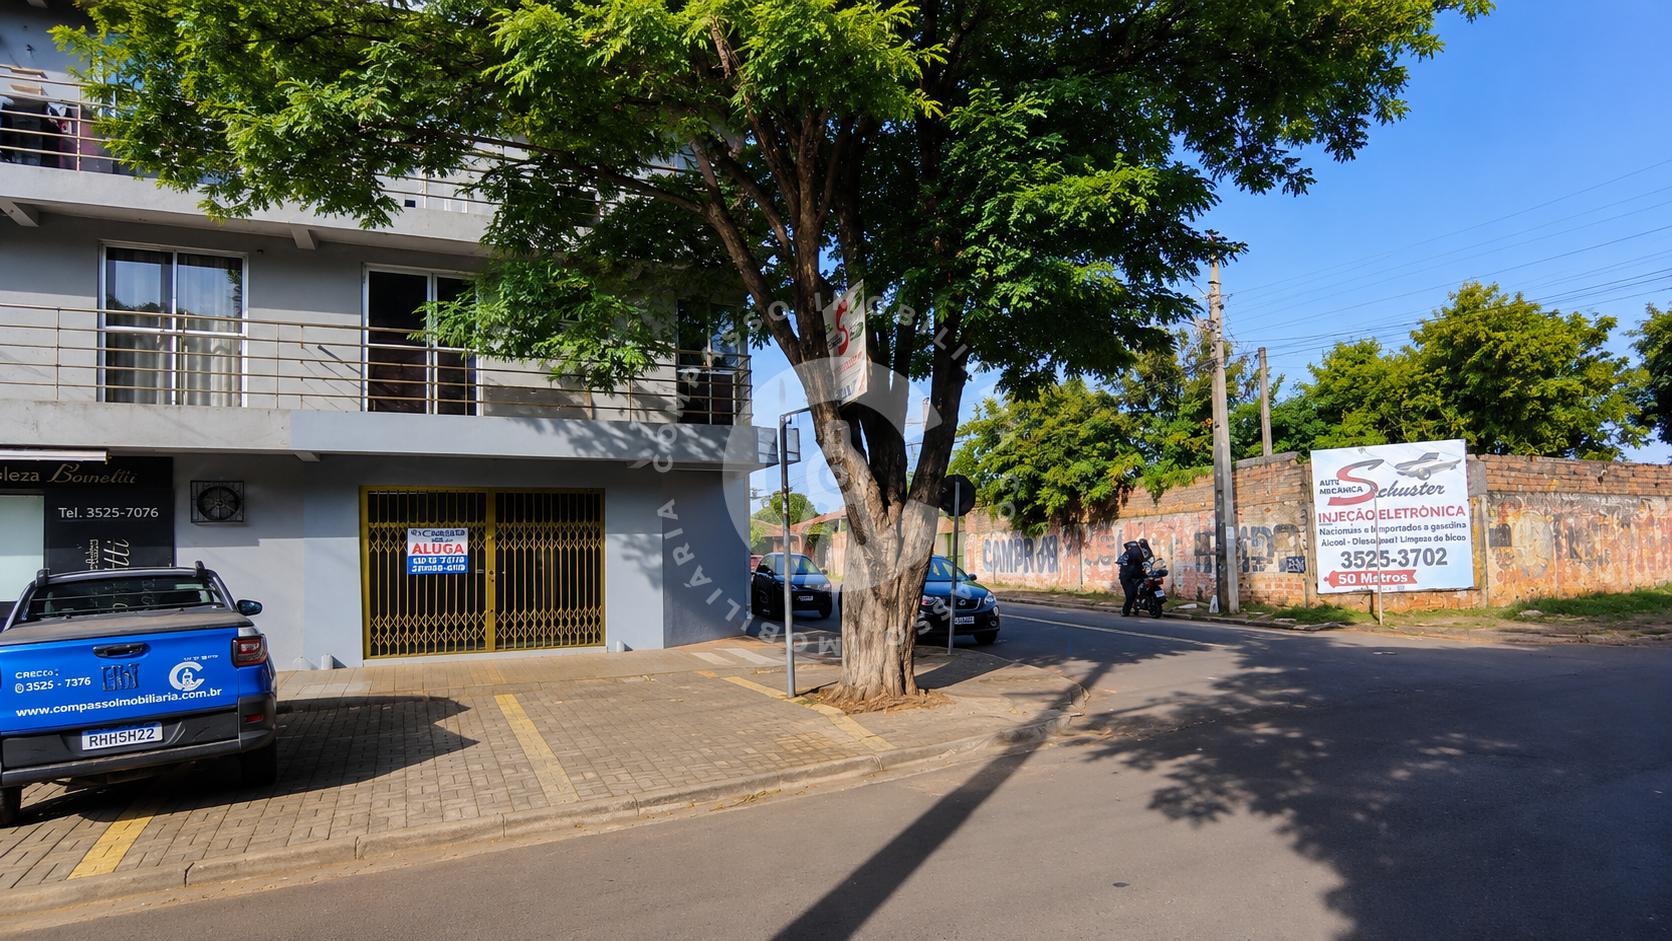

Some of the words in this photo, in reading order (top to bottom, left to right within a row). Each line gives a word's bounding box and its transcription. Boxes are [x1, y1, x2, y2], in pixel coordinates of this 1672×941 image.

[1328, 458, 1445, 506] Schuster
[58, 507, 83, 518] Tel.
[86, 507, 159, 518] 3525-7076
[412, 543, 464, 554] ALUGA
[1340, 547, 1448, 569] 3525-3702
[1338, 573, 1356, 585] 50
[26, 680, 54, 692] 3525
[65, 677, 91, 688] 7376
